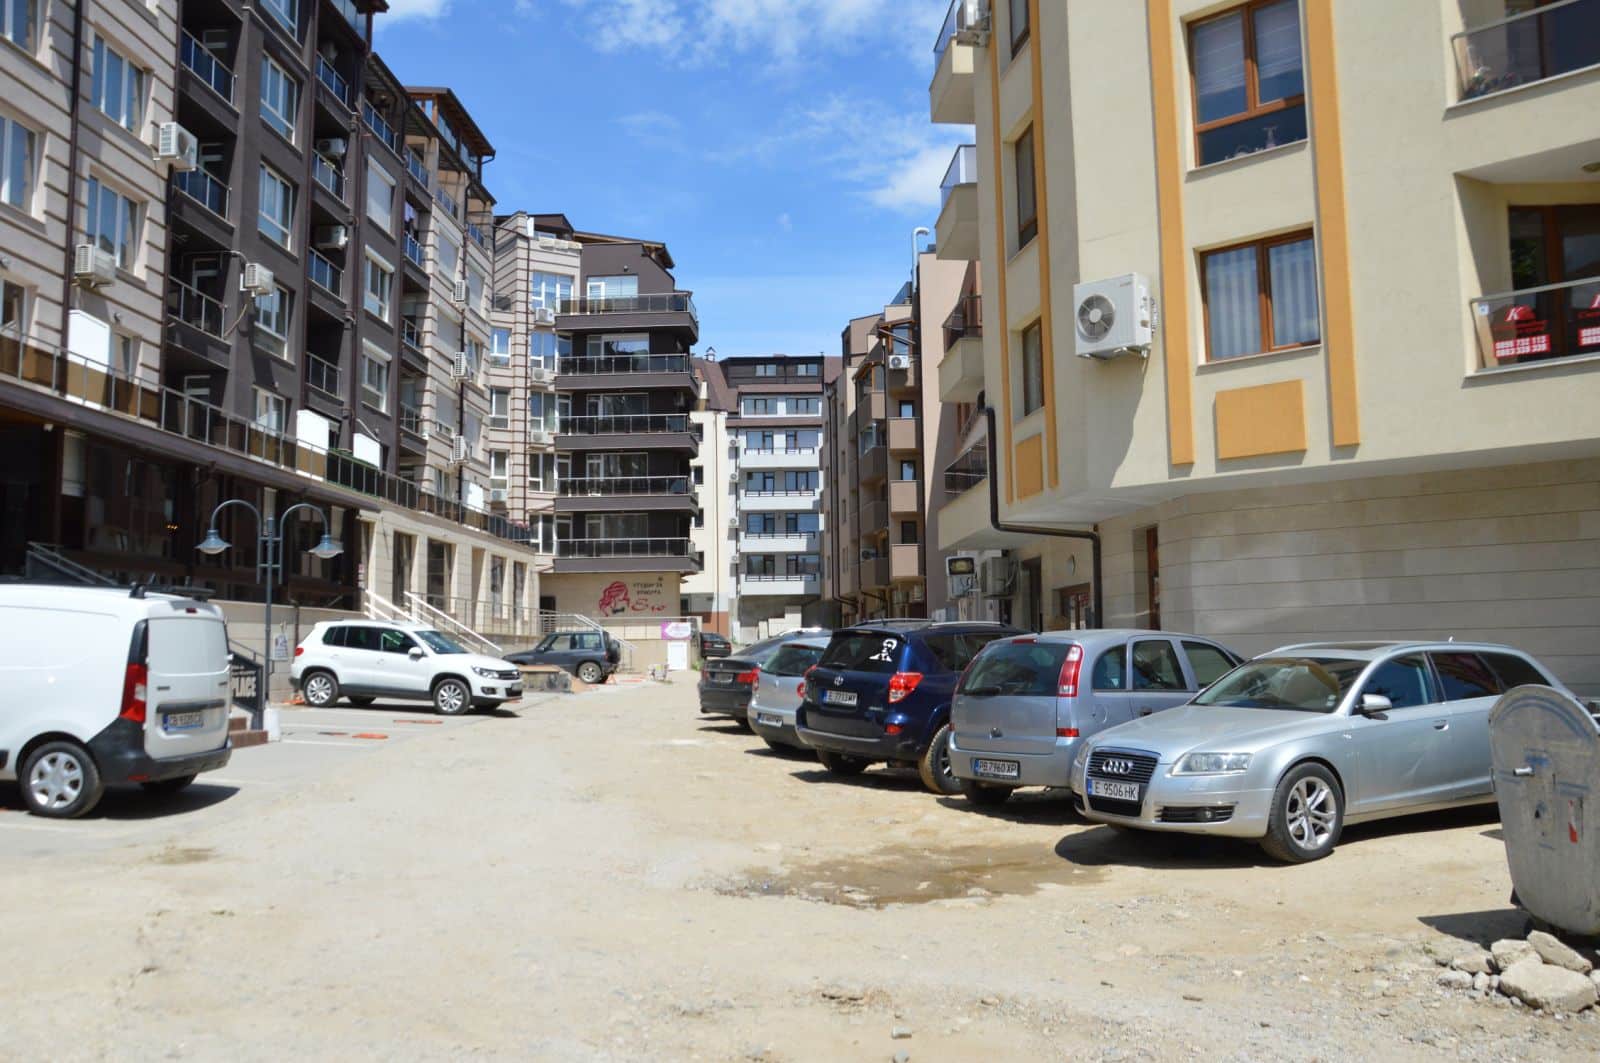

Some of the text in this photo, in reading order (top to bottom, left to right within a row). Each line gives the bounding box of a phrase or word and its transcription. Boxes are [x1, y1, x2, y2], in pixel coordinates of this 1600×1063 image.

[1095, 781, 1137, 799] E 9506 HK
